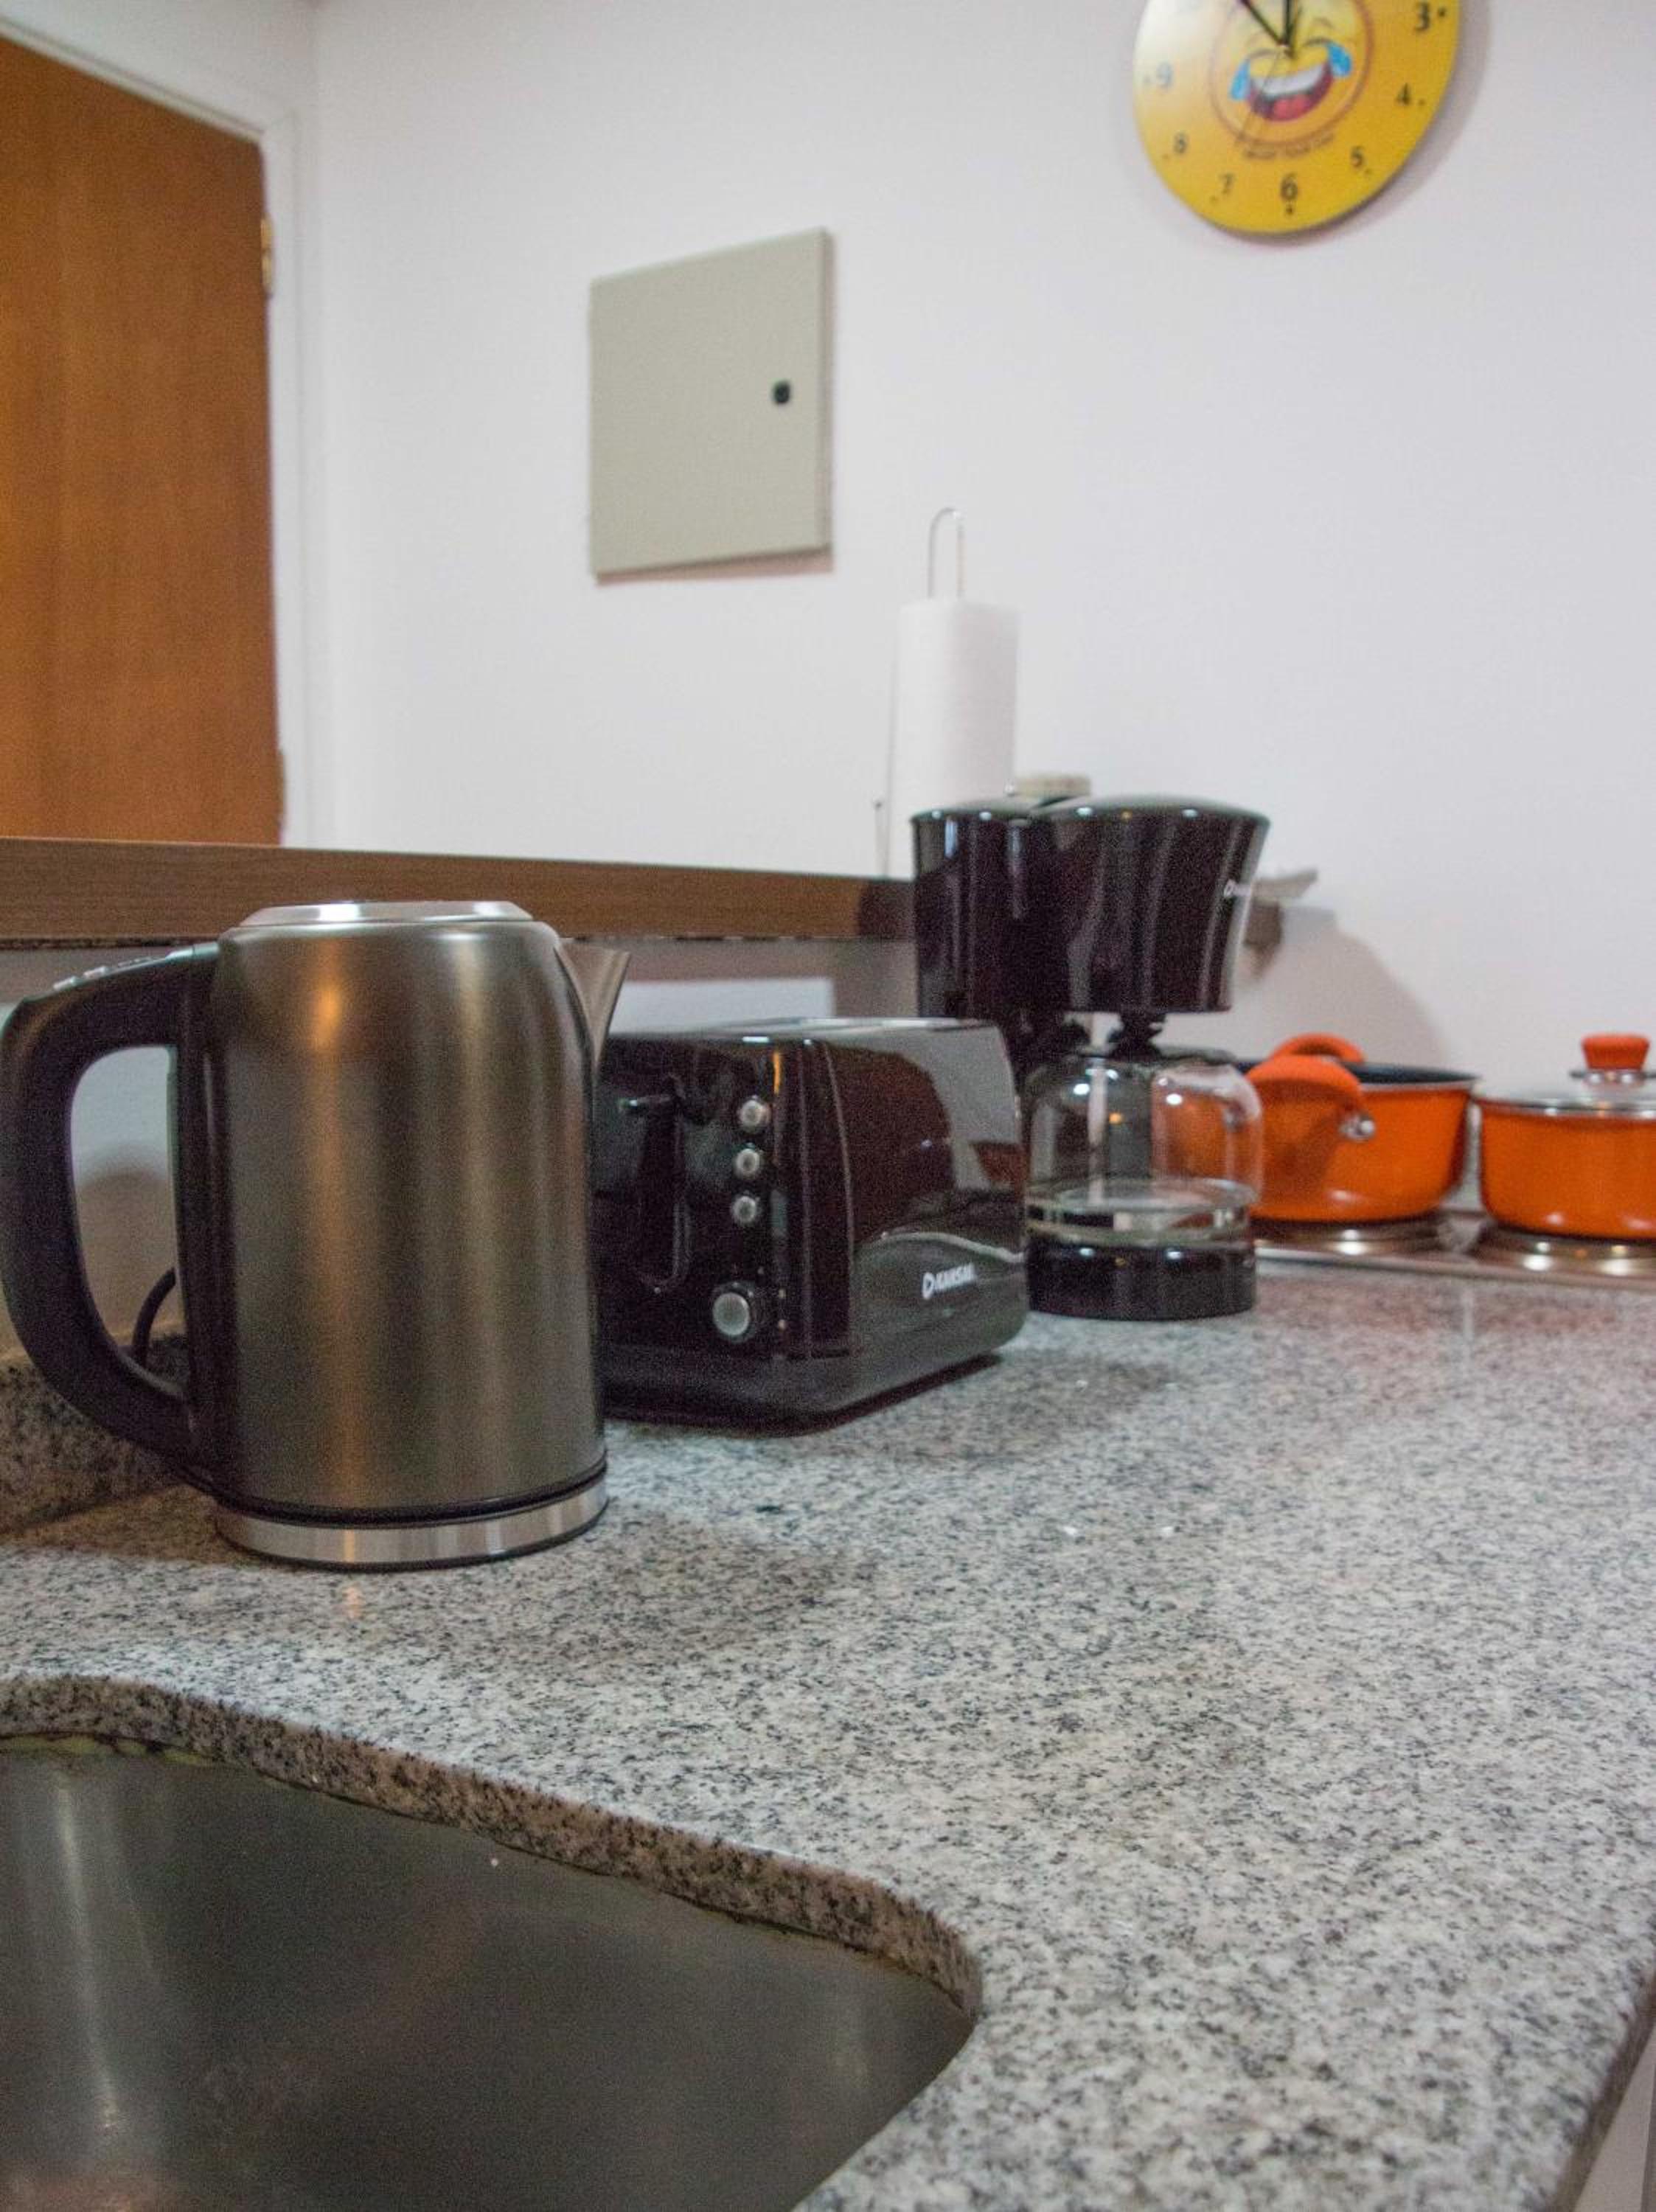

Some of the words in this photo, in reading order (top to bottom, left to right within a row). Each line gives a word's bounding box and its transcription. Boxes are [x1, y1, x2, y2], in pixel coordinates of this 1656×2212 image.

[1416, 2, 1430, 32] 3
[1156, 62, 1173, 89] 9
[1396, 83, 1411, 106] 4
[1174, 133, 1188, 154] 8
[1351, 146, 1364, 168] 5
[1220, 174, 1234, 195] 7
[1280, 175, 1298, 201] 6
